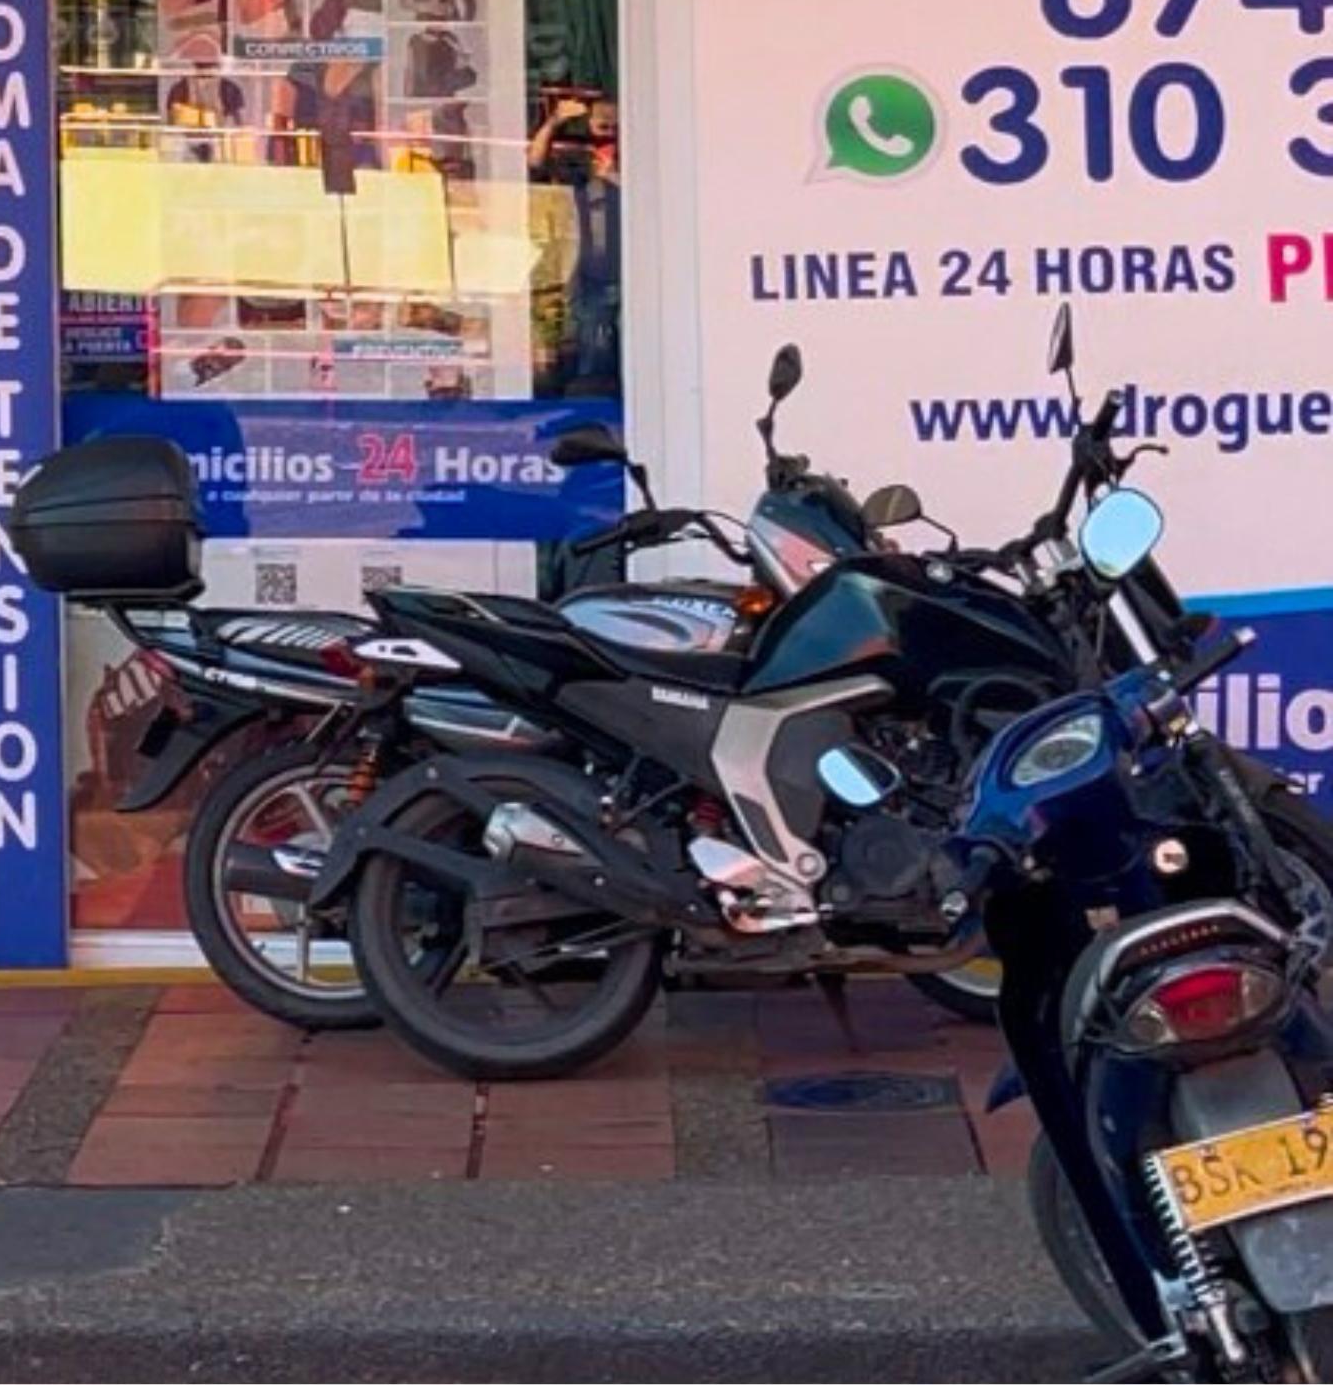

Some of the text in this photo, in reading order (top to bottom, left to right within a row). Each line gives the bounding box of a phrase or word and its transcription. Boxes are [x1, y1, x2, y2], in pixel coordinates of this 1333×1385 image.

[960, 61, 1225, 184] 310
[752, 233, 1333, 302] LINEA 24 HORAS P
[356, 433, 416, 484] 24
[435, 447, 565, 483] Horas
